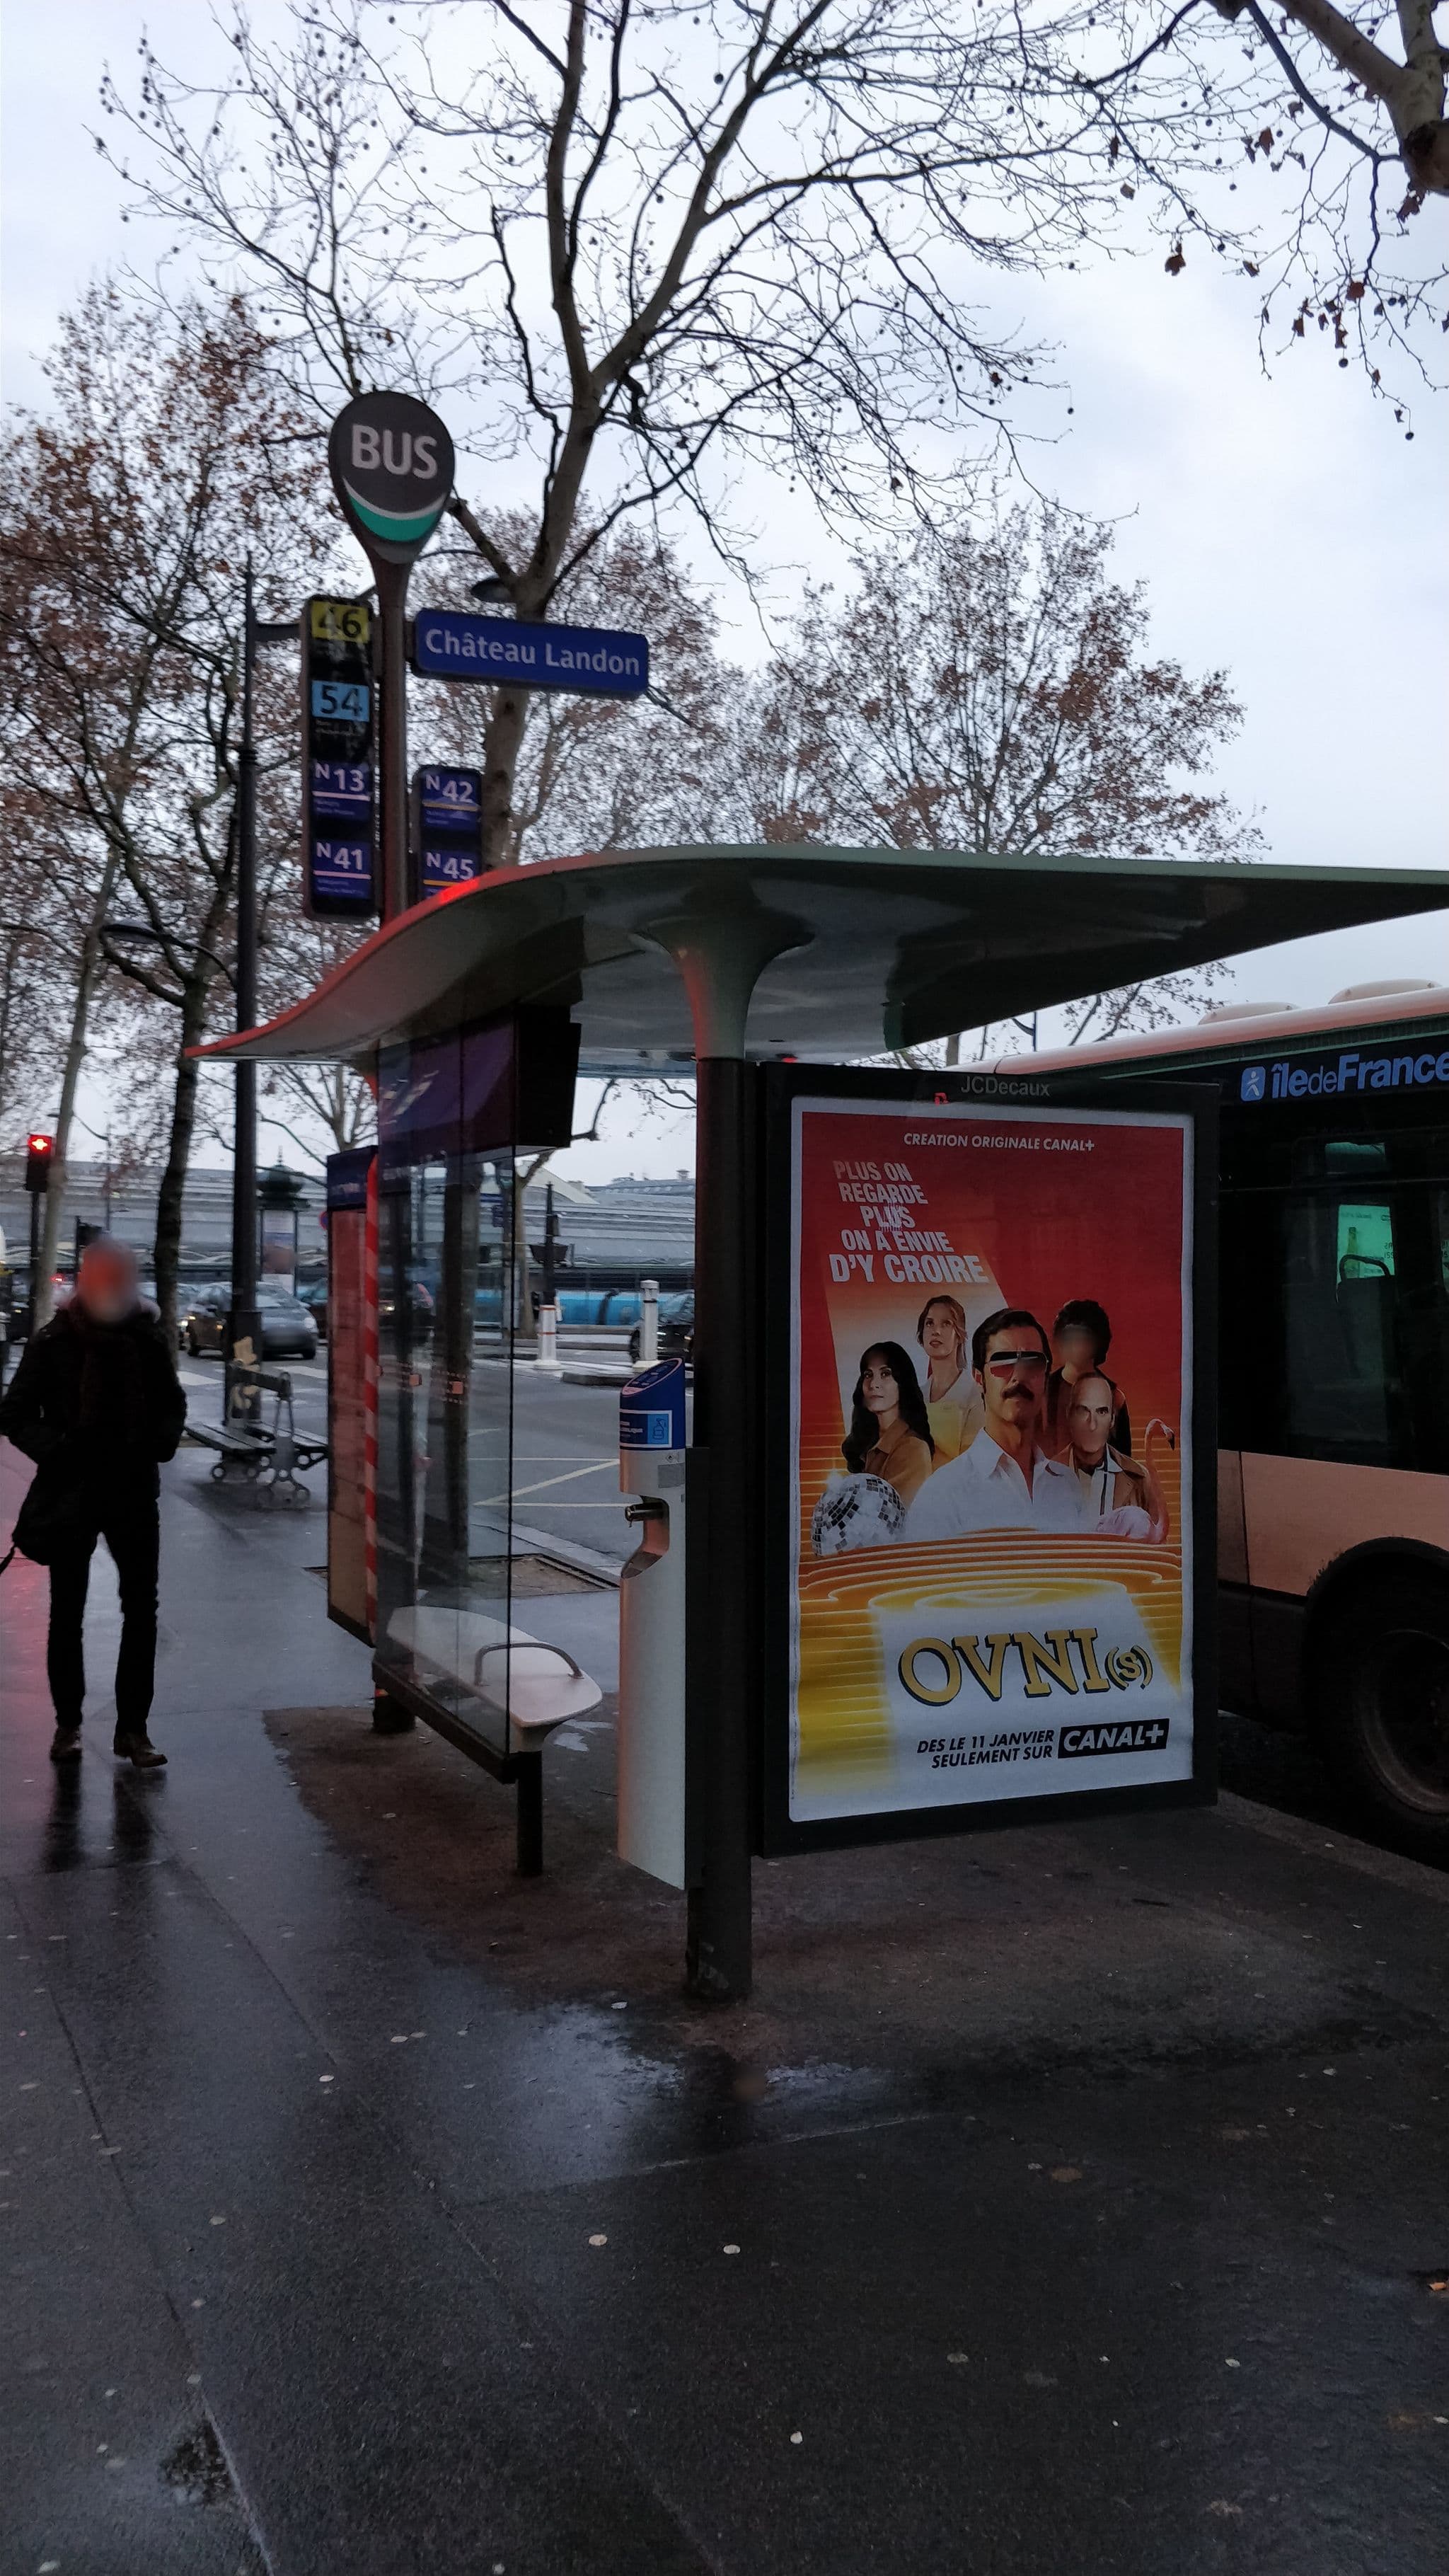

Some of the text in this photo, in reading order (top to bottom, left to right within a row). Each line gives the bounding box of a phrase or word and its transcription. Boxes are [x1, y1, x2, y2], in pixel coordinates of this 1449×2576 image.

[351, 423, 437, 480] BUS
[425, 628, 640, 676] Château Landon
[321, 684, 363, 717] 54
[315, 762, 365, 793] N13
[426, 775, 473, 803] N42
[316, 841, 363, 870] N41
[426, 851, 473, 880] N45
[961, 1075, 1051, 1096] JCDecaux
[904, 1133, 1095, 1151] CREATION ORIGINALE CANAL+
[833, 1161, 913, 1182] PLUS ON
[838, 1183, 928, 1204] REGARDE
[860, 1205, 916, 1229] PLUS
[841, 1229, 954, 1253] ON A ENVIE
[829, 1253, 990, 1283] D'Y CROIRE
[898, 1628, 1153, 1706] OVNI(s)
[918, 1730, 1055, 1754] DES LE 11 JANVIER
[1063, 1723, 1165, 1752] CANAL+
[931, 1744, 1053, 1769] SEULEMENT SUR
